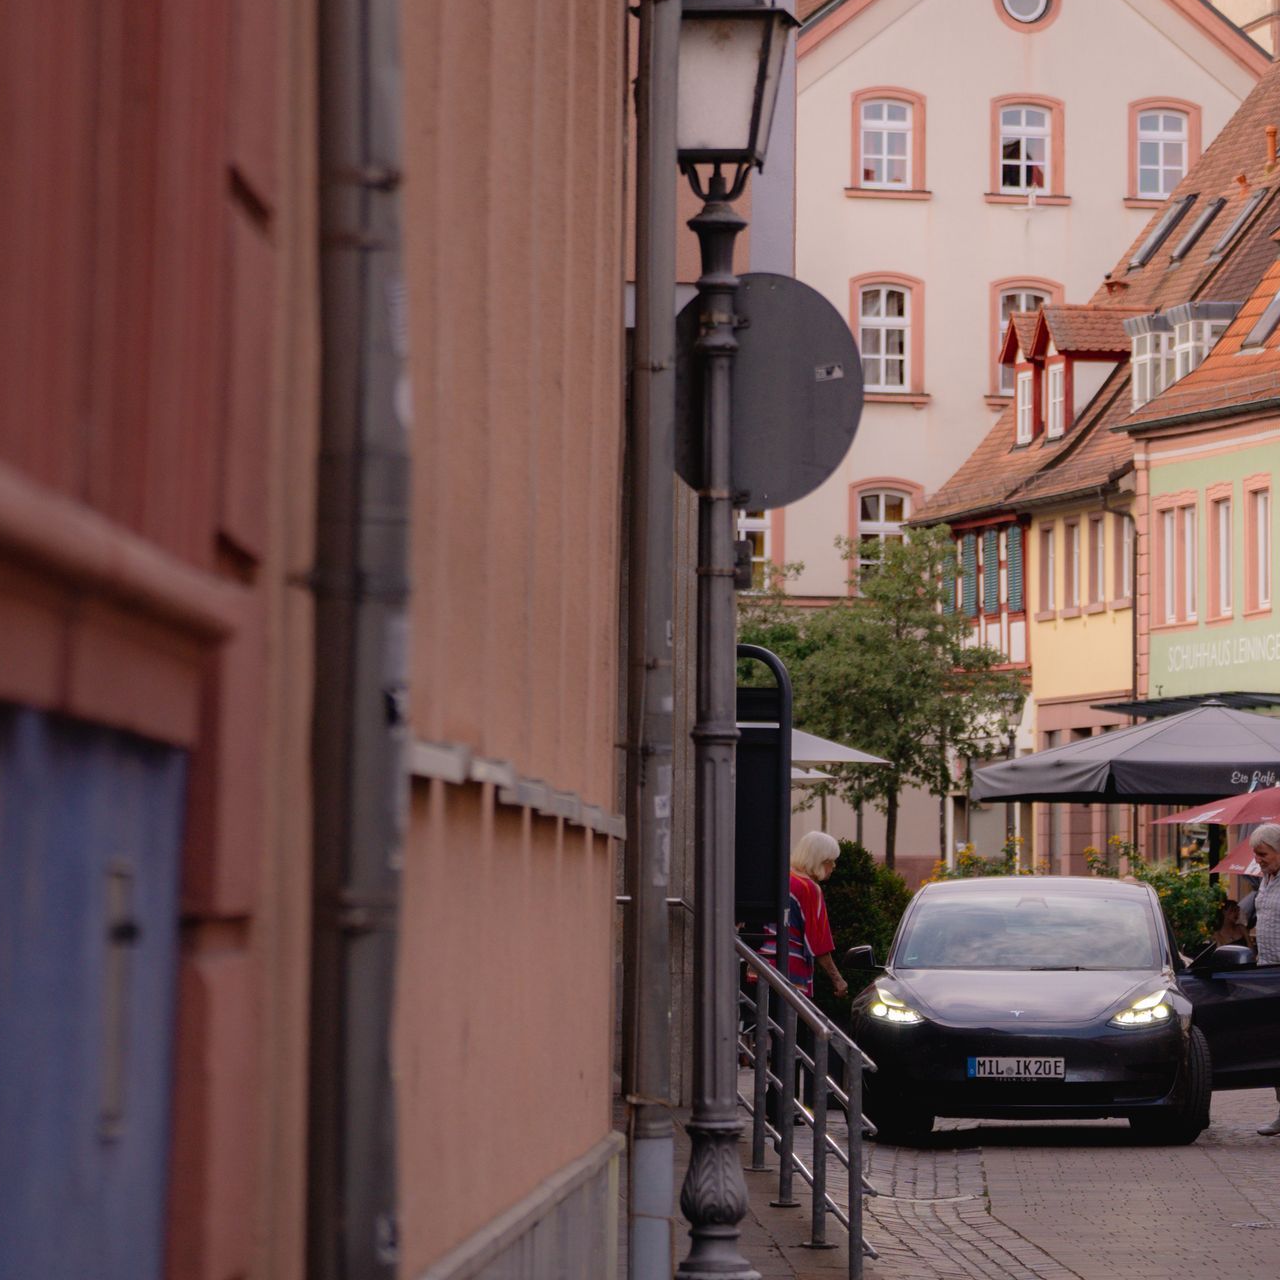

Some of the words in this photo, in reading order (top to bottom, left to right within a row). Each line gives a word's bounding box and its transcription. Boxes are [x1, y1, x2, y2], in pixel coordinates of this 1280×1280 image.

[1167, 639, 1231, 673] SCHUHHAUS
[1230, 770, 1249, 784] Eis
[977, 1060, 1004, 1075] MIL
[1015, 1060, 1063, 1076] IK20E
